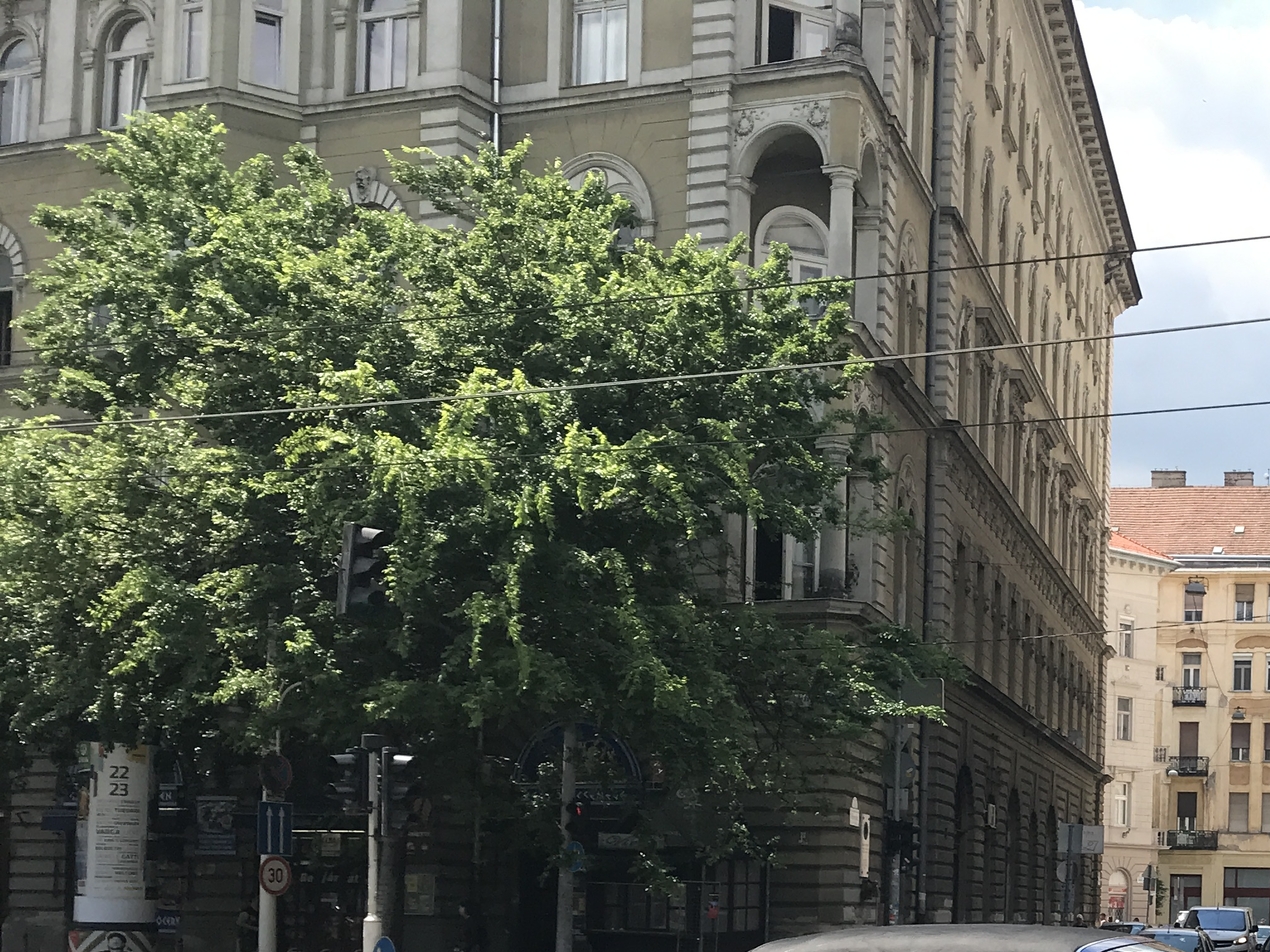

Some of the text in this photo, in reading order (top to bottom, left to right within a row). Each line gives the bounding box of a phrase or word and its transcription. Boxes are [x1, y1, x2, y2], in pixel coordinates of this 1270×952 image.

[109, 765, 129, 779] 22
[109, 783, 129, 797] 23
[268, 867, 283, 883] 30
